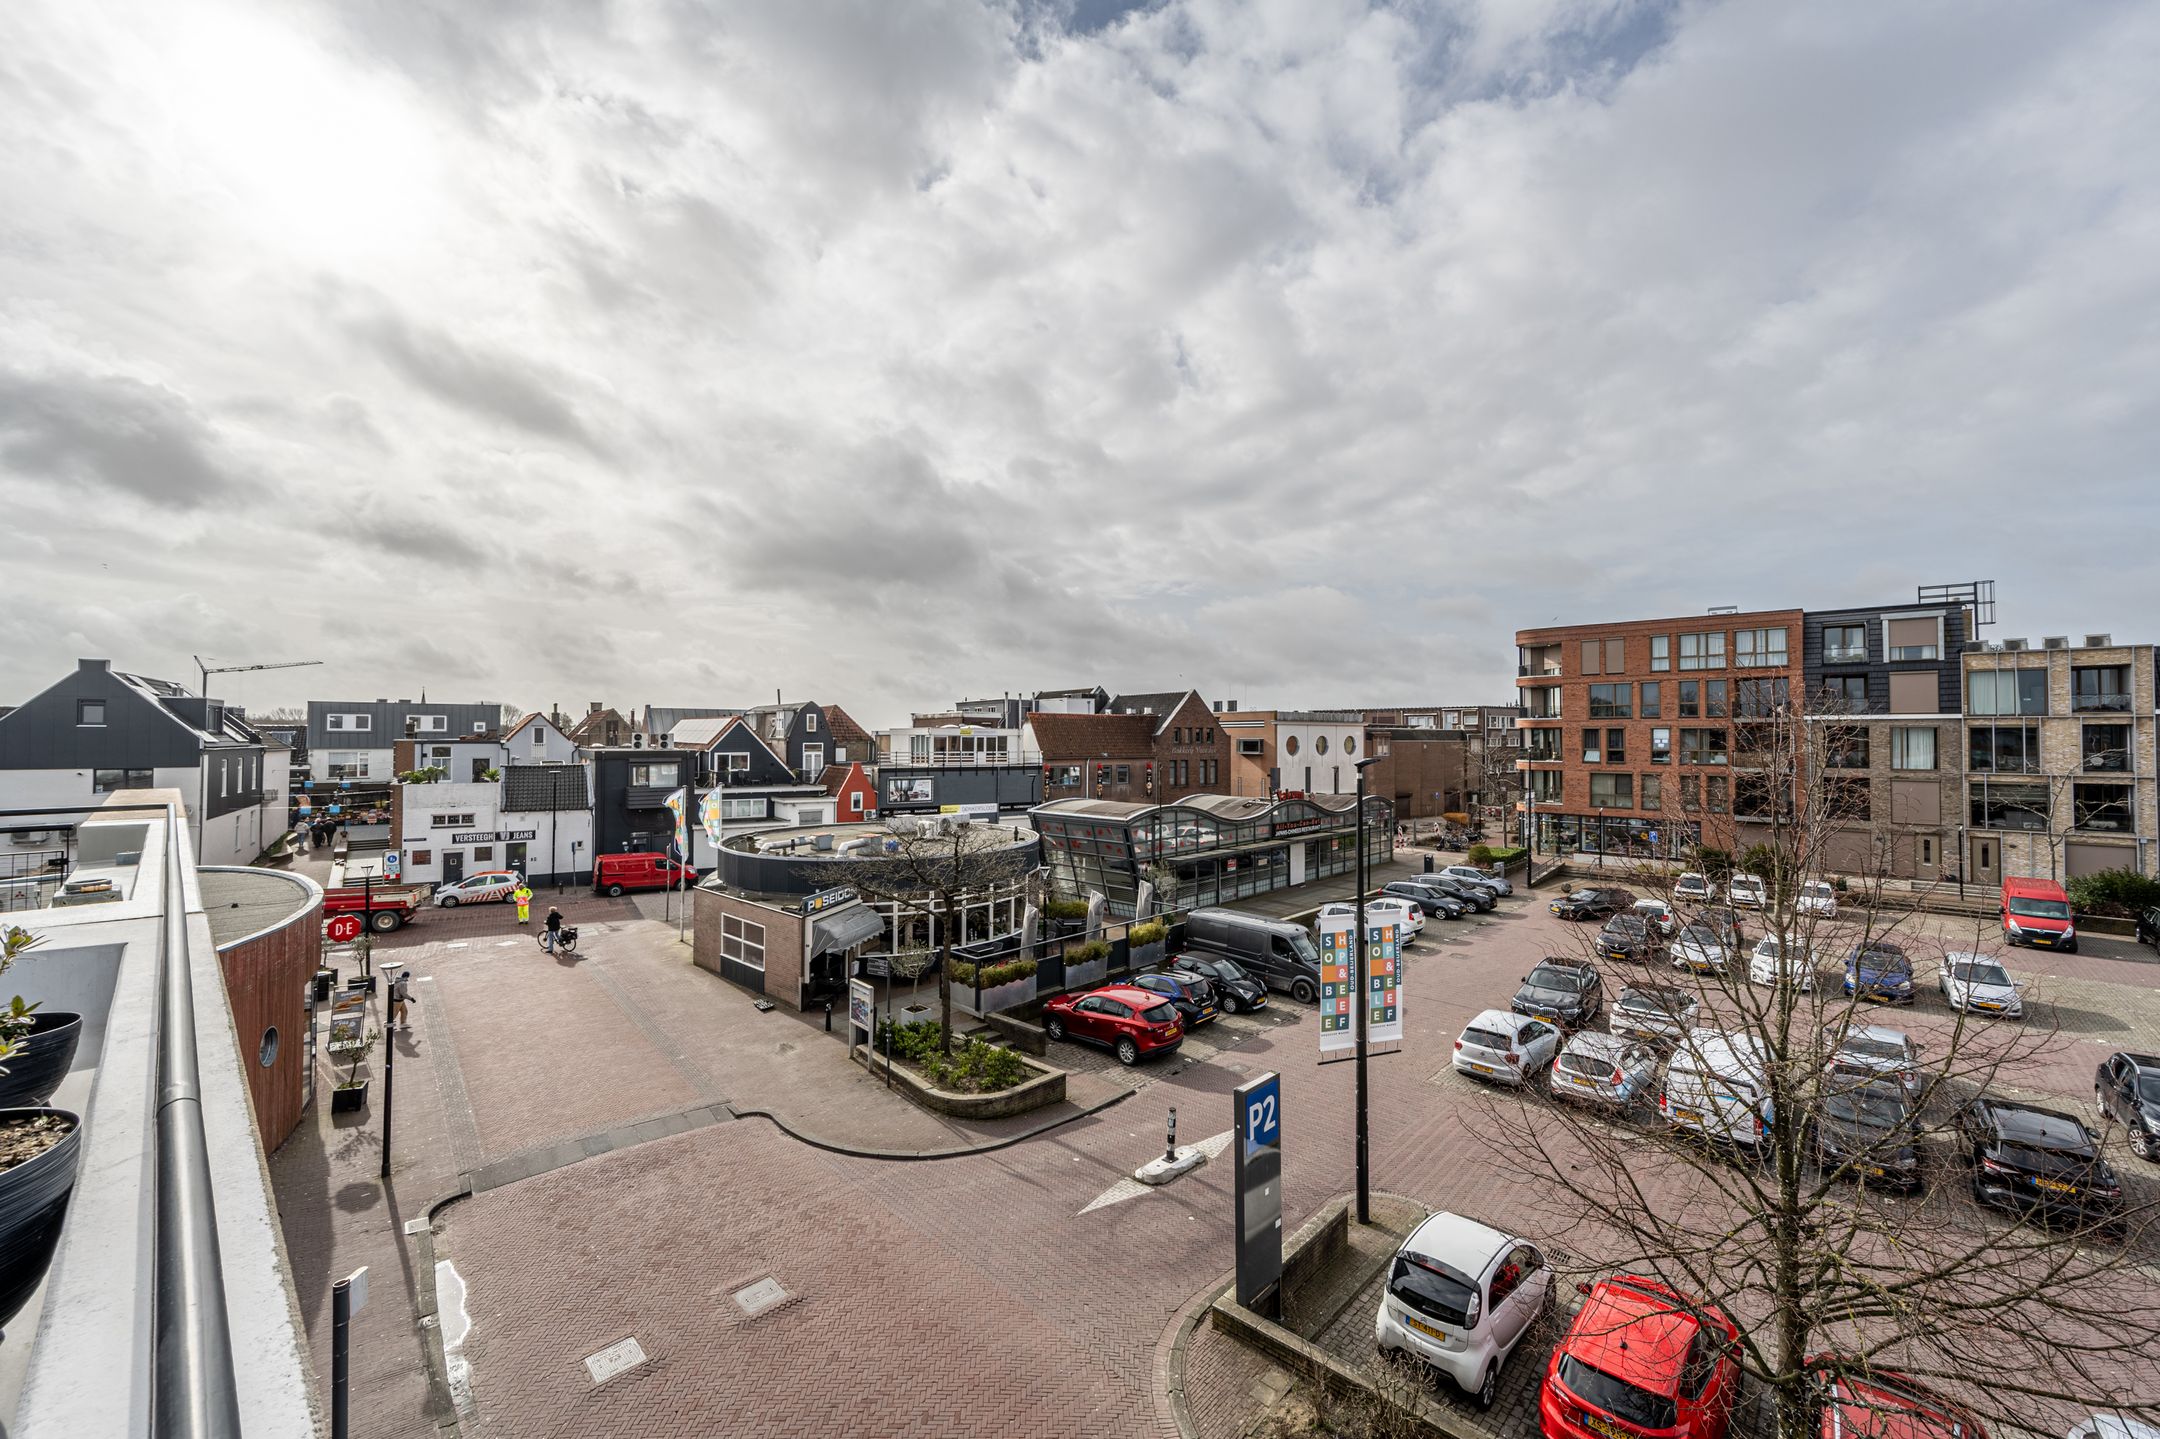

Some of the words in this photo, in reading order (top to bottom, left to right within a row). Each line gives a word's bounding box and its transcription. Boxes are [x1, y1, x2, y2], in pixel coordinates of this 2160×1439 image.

[455, 833, 494, 842] VERSTEEGH
[500, 831, 510, 840] VJ
[512, 831, 533, 840] JEANS
[1249, 1094, 1276, 1142] P2
